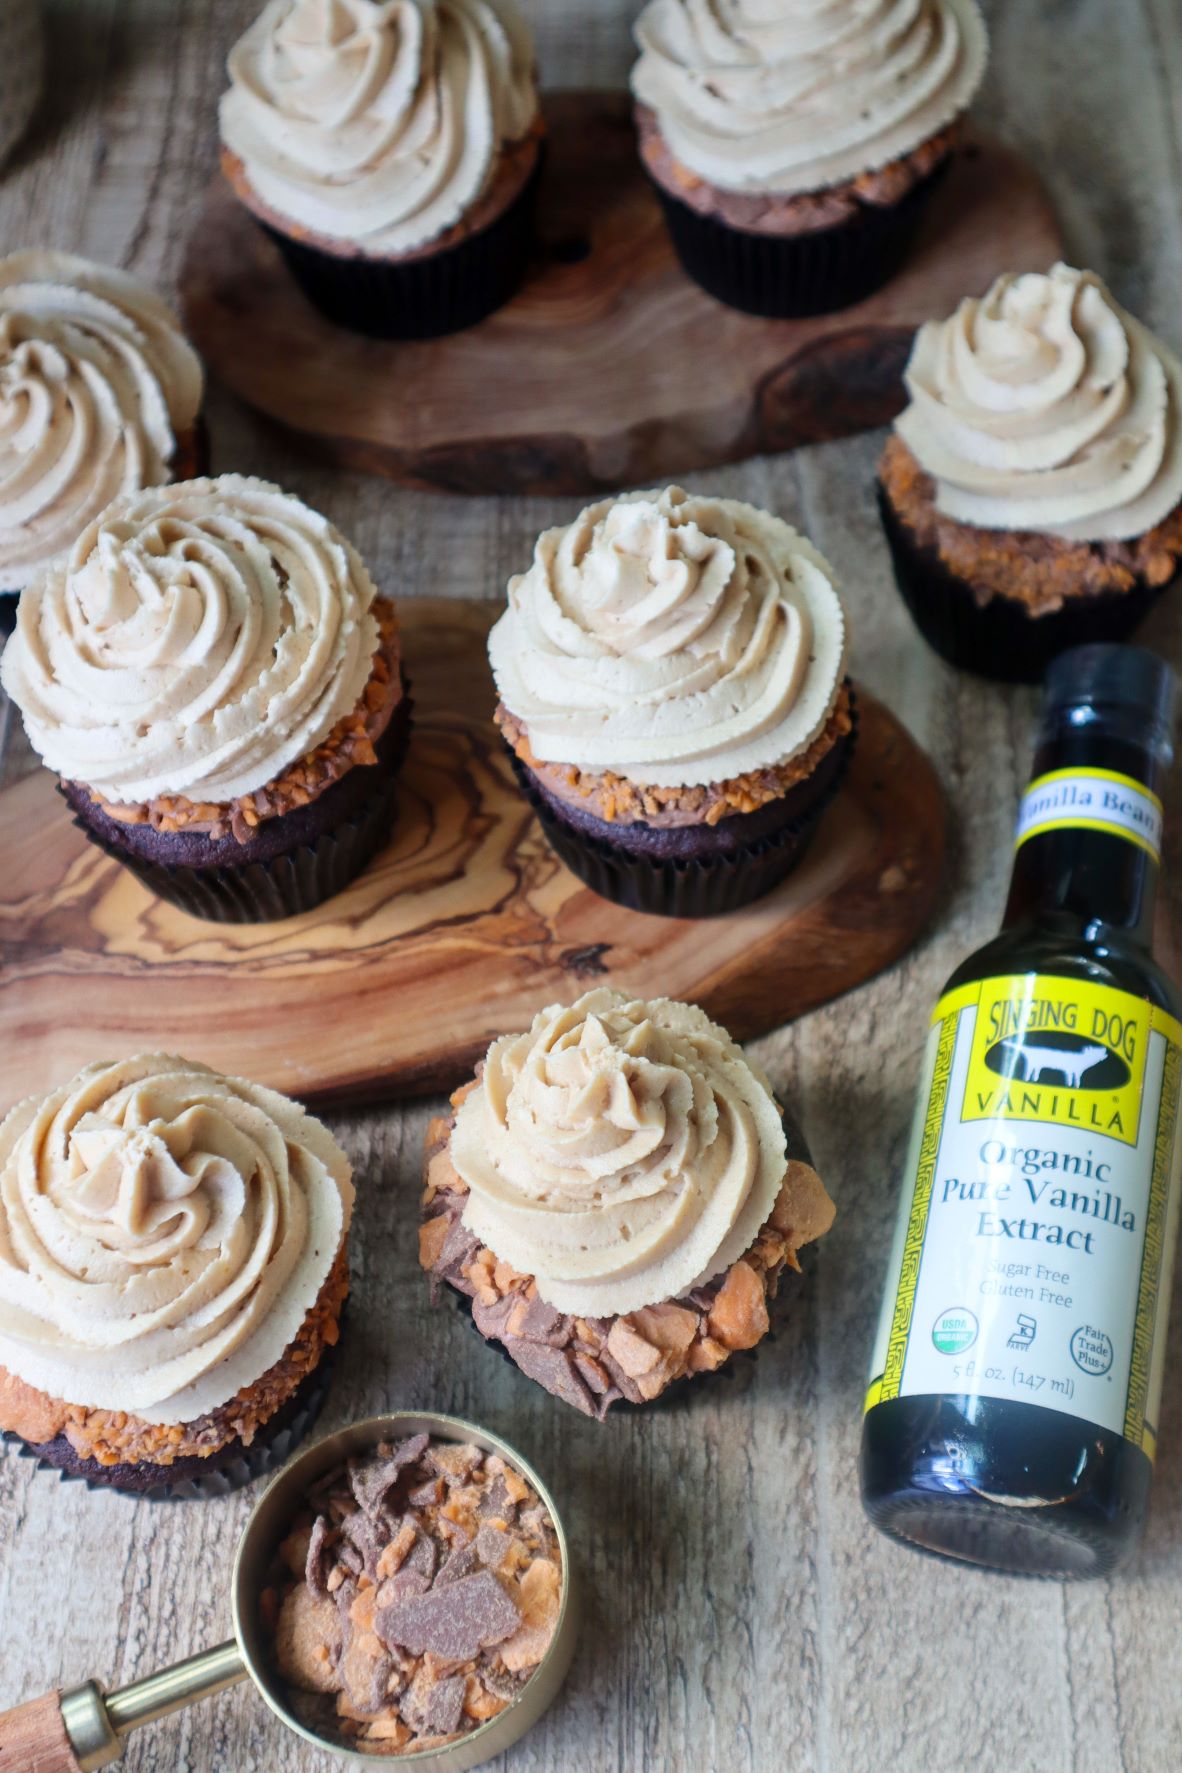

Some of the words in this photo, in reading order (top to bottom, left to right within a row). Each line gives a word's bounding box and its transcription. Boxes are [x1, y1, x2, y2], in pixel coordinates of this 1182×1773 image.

[1025, 785, 1093, 818] anilla
[1102, 790, 1155, 832] Bean
[985, 999, 1078, 1045] SINGING
[1090, 1007, 1137, 1063] DOG
[977, 1092, 1124, 1134] VANILLA
[979, 1140, 1112, 1183] Organic
[941, 1177, 1012, 1203] Pure
[1023, 1178, 1136, 1233] Vanilla
[975, 1211, 1096, 1255] Extract
[987, 1260, 1032, 1279] Sugar
[1036, 1263, 1070, 1285] Free
[979, 1279, 1034, 1300] Gluten
[1039, 1286, 1073, 1309] Free
[1078, 1336, 1109, 1358] Trade
[1085, 1324, 1106, 1341] Fair
[953, 1364, 962, 1379] 5
[984, 1367, 1006, 1381] oz.
[1012, 1366, 1046, 1391] (147
[1051, 1377, 1075, 1400] ml)
